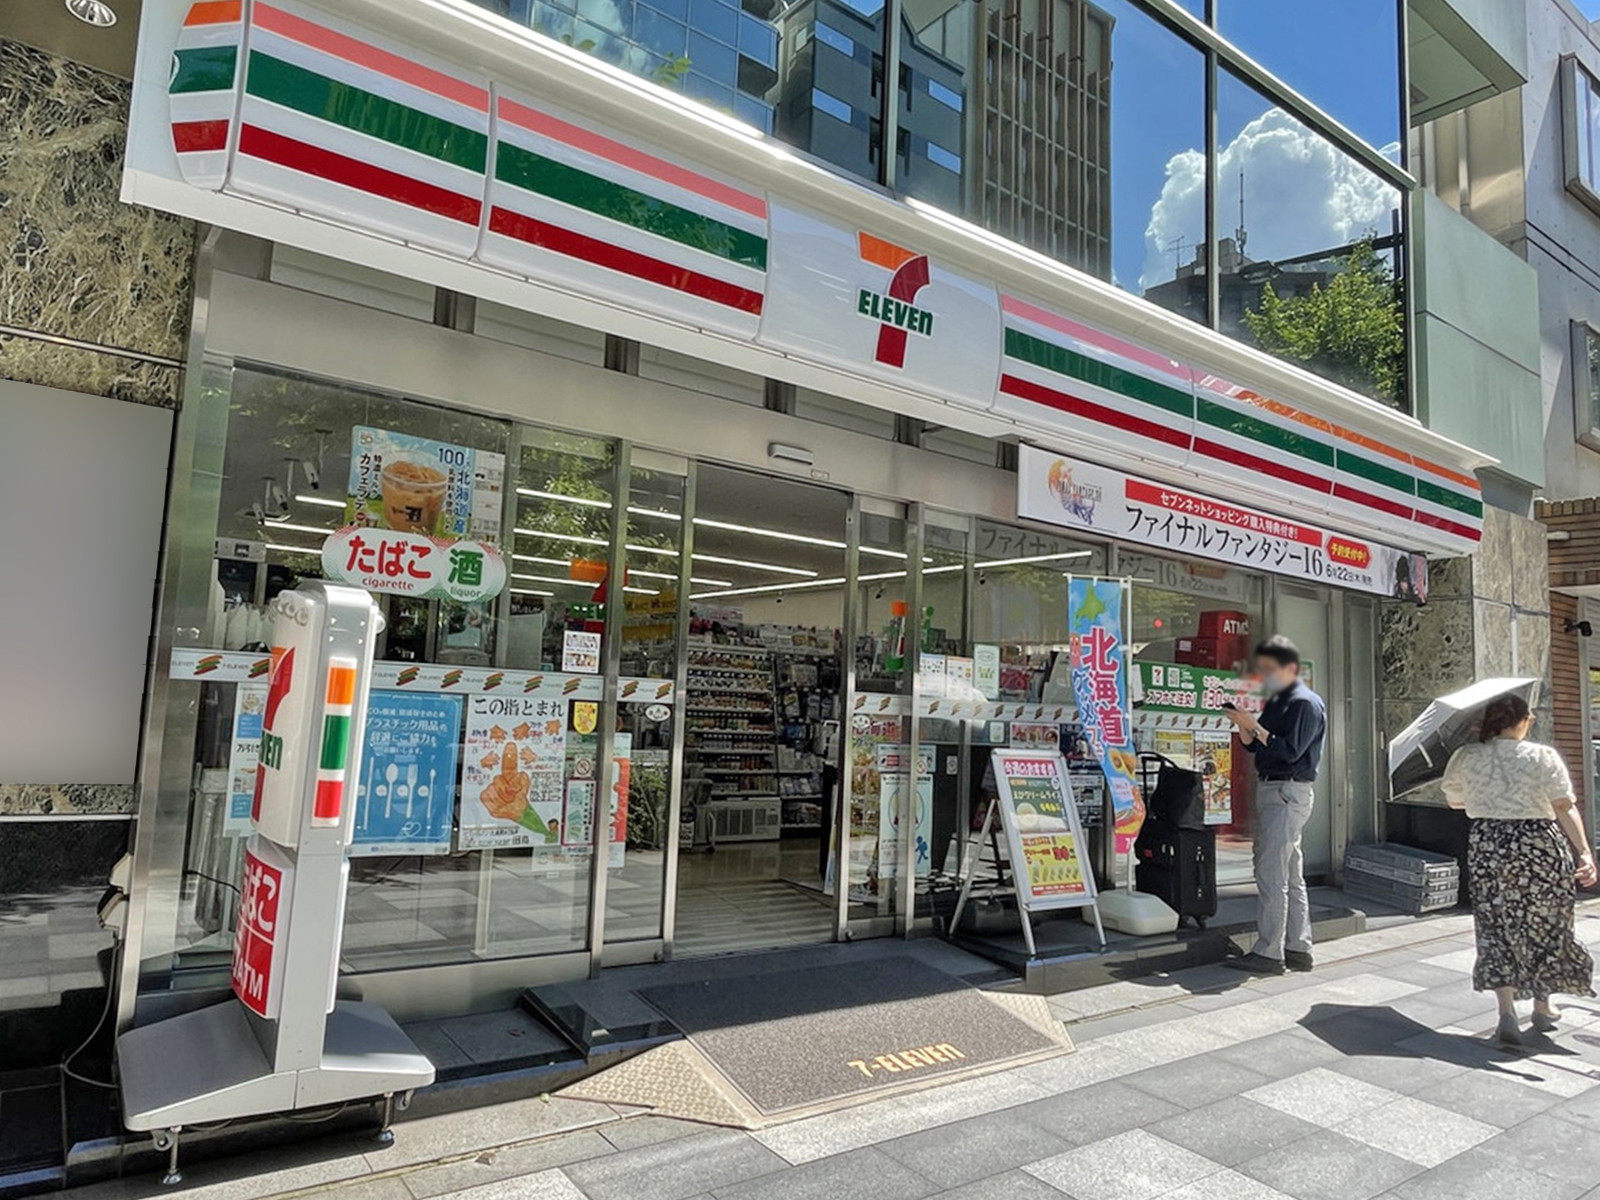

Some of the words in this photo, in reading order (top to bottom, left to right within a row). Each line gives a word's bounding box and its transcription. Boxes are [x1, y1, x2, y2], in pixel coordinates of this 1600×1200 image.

[858, 288, 934, 337] ELEVEN
[354, 452, 371, 511] カフェラテ
[345, 535, 432, 579] たばこ
[1125, 504, 1323, 577] ファイナルファンタジー16
[362, 577, 415, 592] cigarette
[447, 548, 484, 587] 酒
[450, 586, 482, 599] liquor
[1080, 627, 1127, 747] 北海道
[474, 698, 565, 718] この指とまれ
[846, 1043, 966, 1078] 7-ELEVEN
